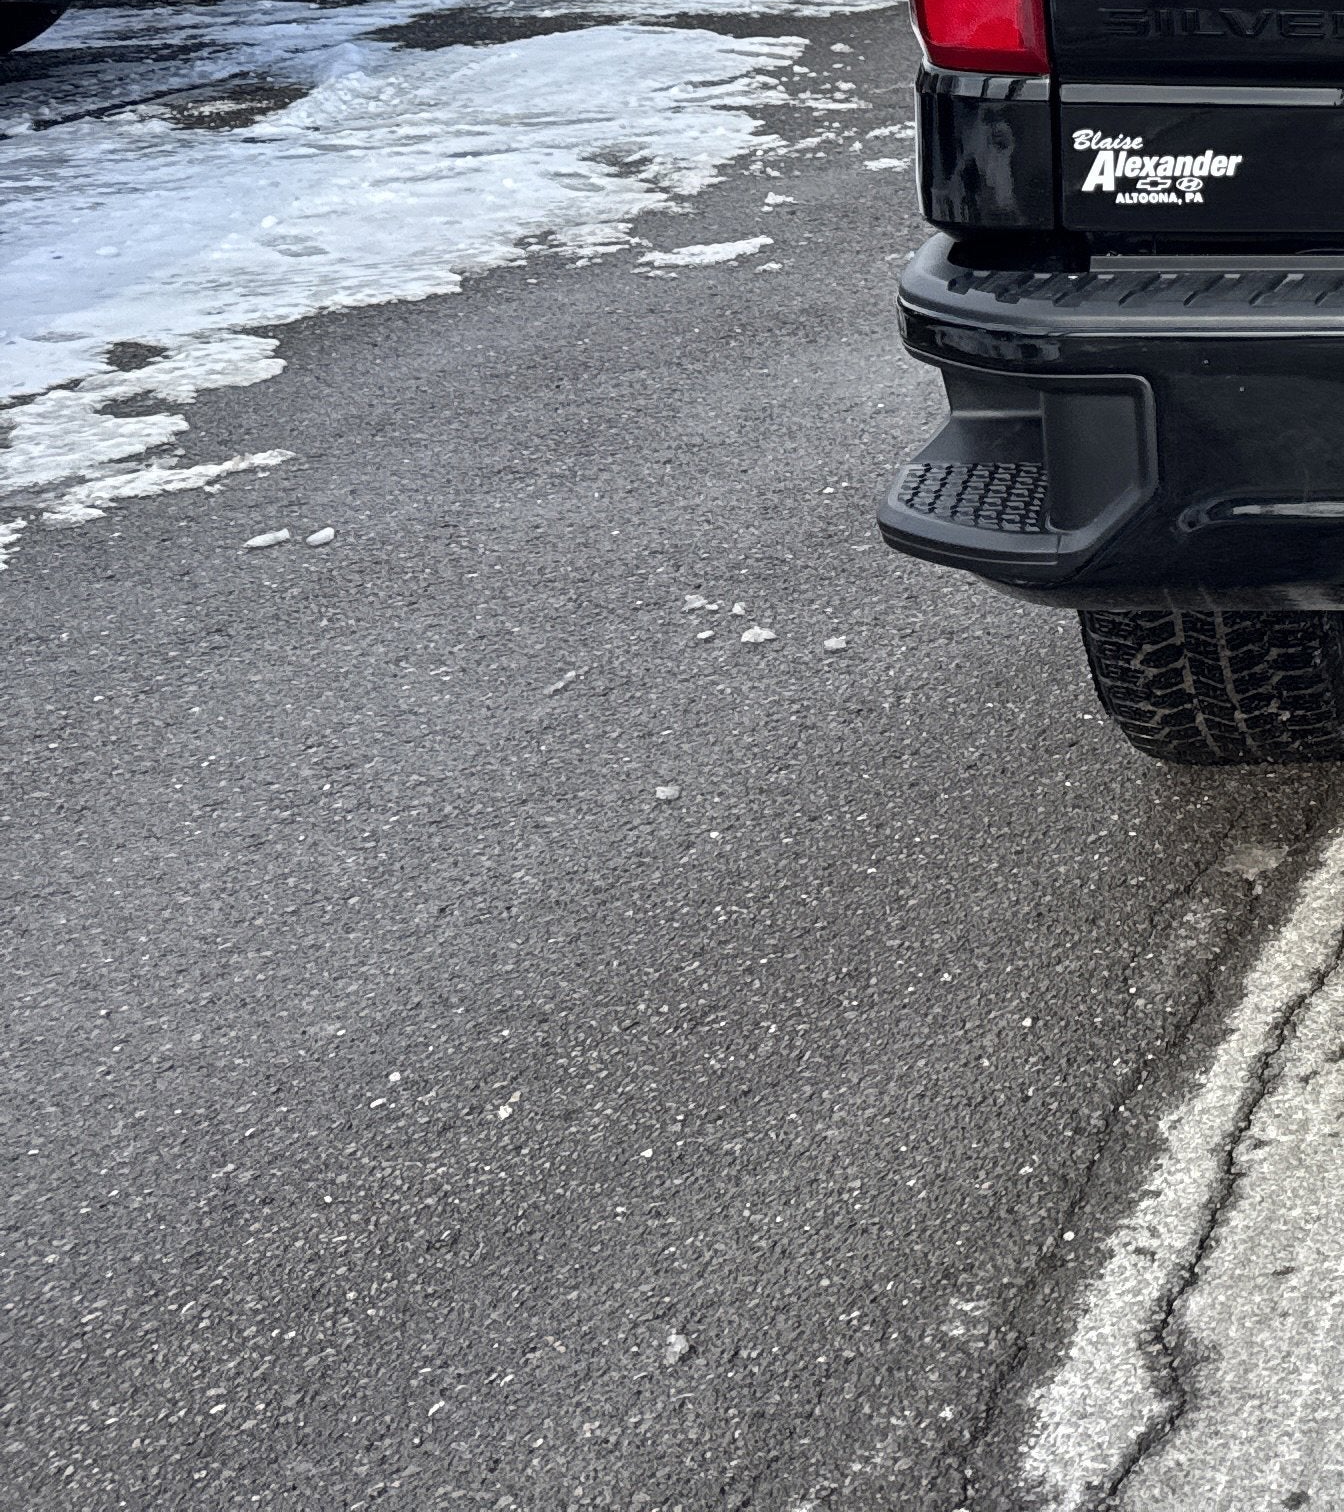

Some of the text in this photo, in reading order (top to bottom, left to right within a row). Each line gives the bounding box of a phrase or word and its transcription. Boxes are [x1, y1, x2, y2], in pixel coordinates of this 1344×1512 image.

[1072, 129, 1144, 150] Blaise
[1081, 149, 1243, 192] Alexander
[1115, 192, 1204, 205] ALTOONA, PA
